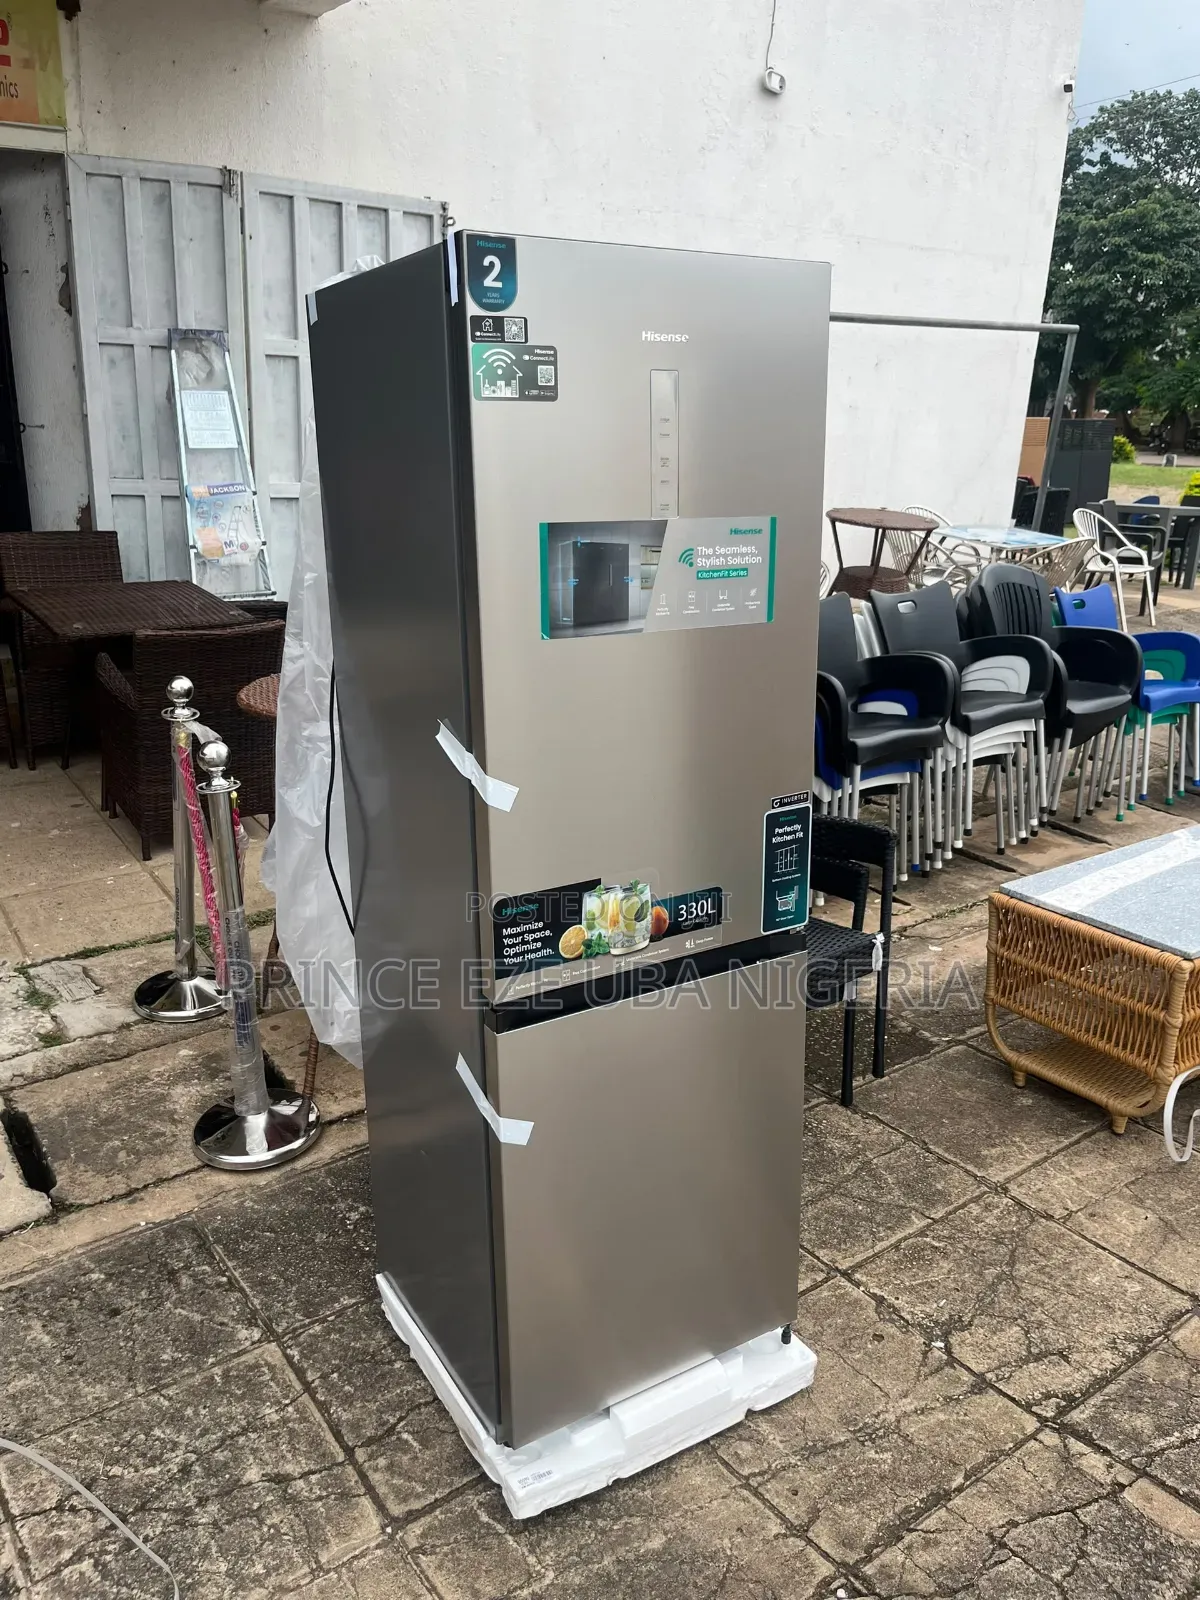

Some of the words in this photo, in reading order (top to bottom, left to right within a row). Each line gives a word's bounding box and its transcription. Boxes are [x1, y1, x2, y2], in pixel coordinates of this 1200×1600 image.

[476, 240, 507, 249] Hisense
[483, 255, 503, 288] 2
[642, 330, 689, 342] Hisense
[210, 484, 246, 495] JACKSON
[697, 546, 713, 555] The
[715, 544, 758, 555] Seamless,
[696, 557, 726, 568] Stylish
[727, 554, 762, 565] Solution
[698, 570, 728, 579] KitchenFit
[729, 569, 747, 577] Series
[782, 793, 807, 803] INVERTER
[774, 824, 801, 834] Perfectly
[772, 834, 795, 843] Kitchen
[502, 903, 539, 915] Hisense
[678, 897, 716, 921] 330L
[502, 921, 544, 936] Maximize
[503, 936, 523, 945] Your
[524, 929, 553, 941] Space,
[503, 941, 542, 956] Optimize
[503, 956, 523, 965] Your
[524, 948, 555, 961] Health.
